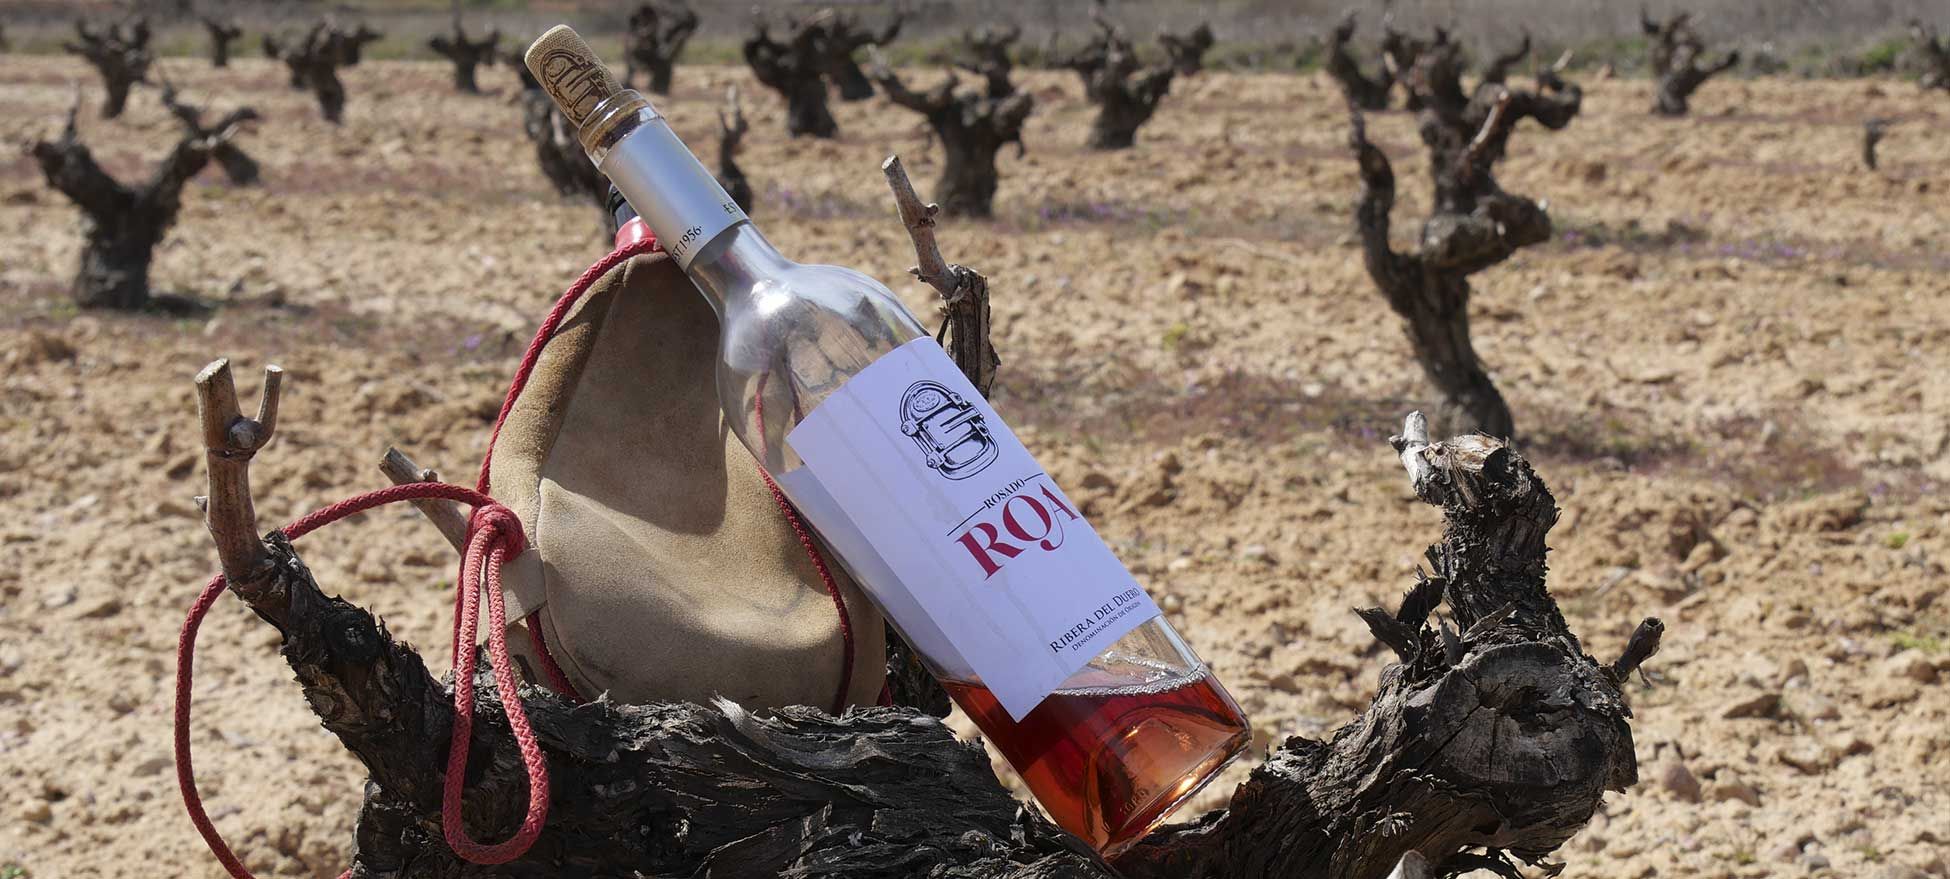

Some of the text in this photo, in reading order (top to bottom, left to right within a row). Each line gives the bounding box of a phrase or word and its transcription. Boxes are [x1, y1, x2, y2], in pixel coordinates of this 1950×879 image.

[983, 478, 1025, 509] ROSADO
[953, 482, 1081, 581] ROA
[1049, 587, 1141, 653] RIBERA DEL DUERO
